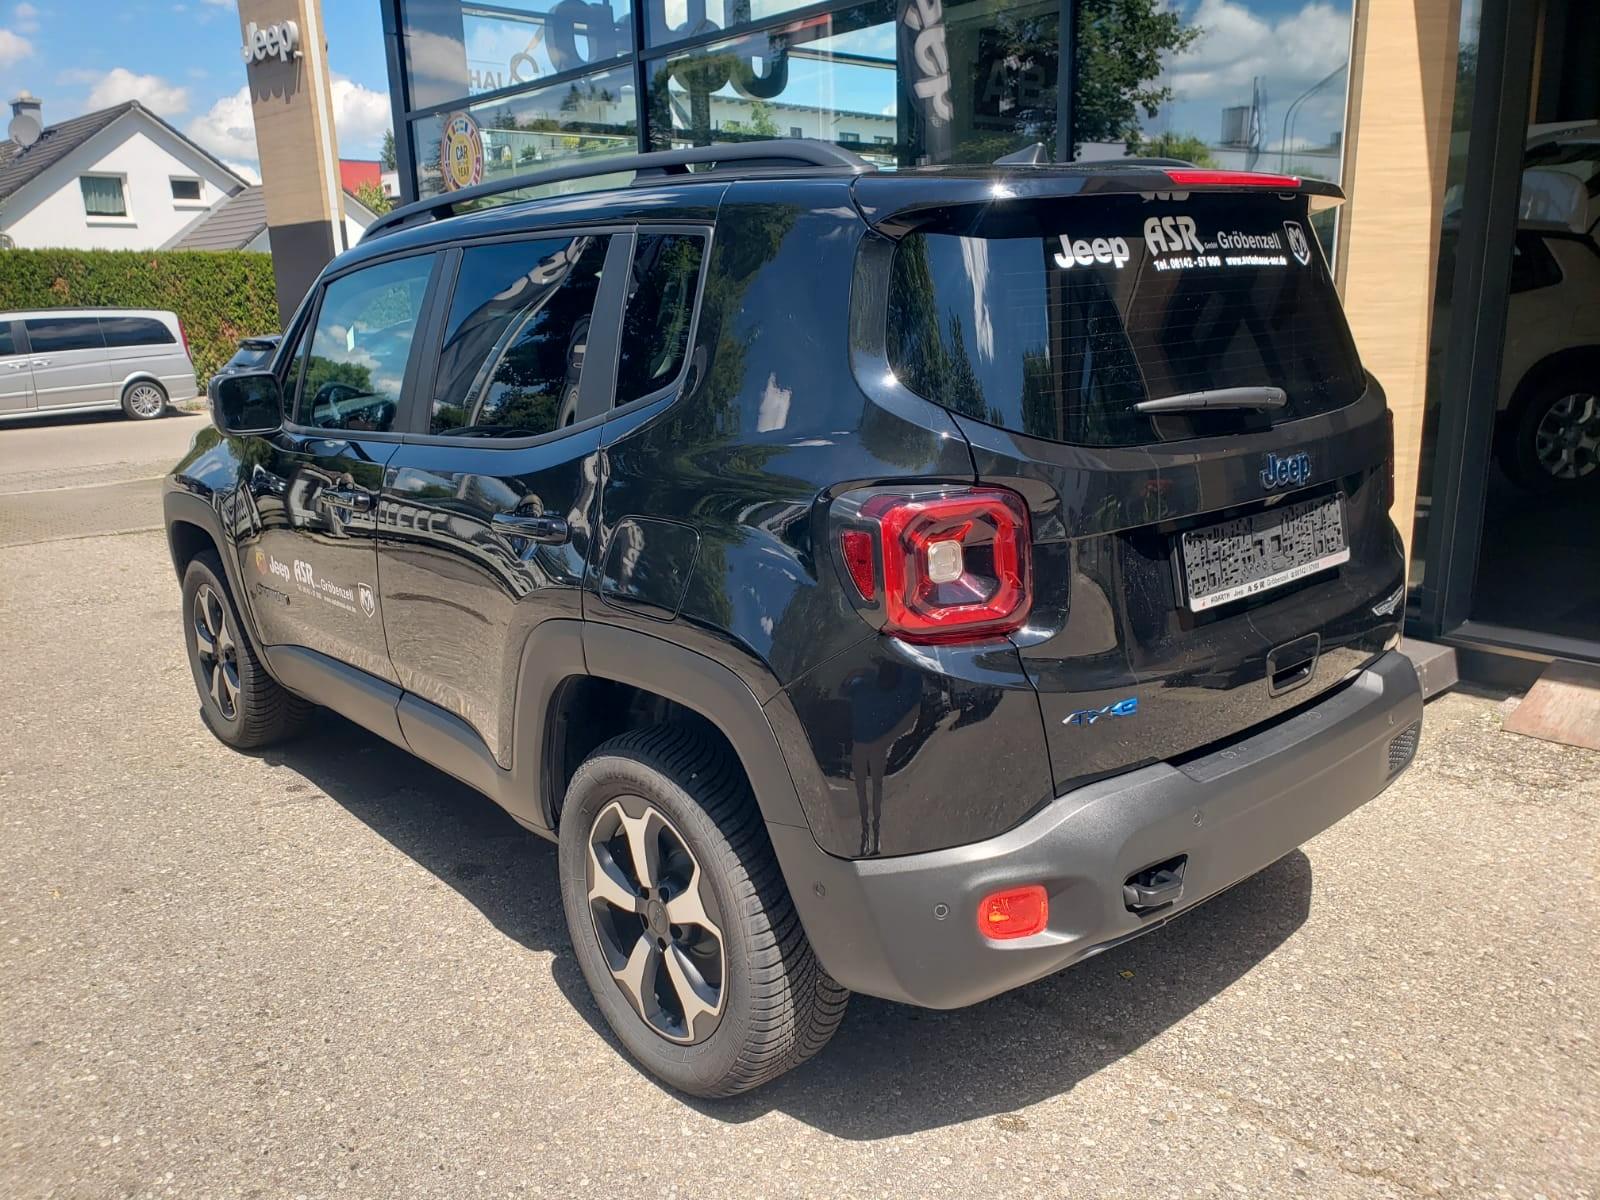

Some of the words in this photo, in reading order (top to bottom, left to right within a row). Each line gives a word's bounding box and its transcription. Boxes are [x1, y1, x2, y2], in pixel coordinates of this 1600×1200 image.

[241, 21, 299, 64] Jeep
[1054, 234, 1130, 269] Jeep
[1144, 216, 1204, 256] ASR
[1217, 231, 1282, 250] Gröbenzell
[1154, 259, 1170, 272] Tel.
[1260, 451, 1311, 489] Jeep
[269, 555, 290, 582] Jeep
[293, 559, 315, 589] ASR
